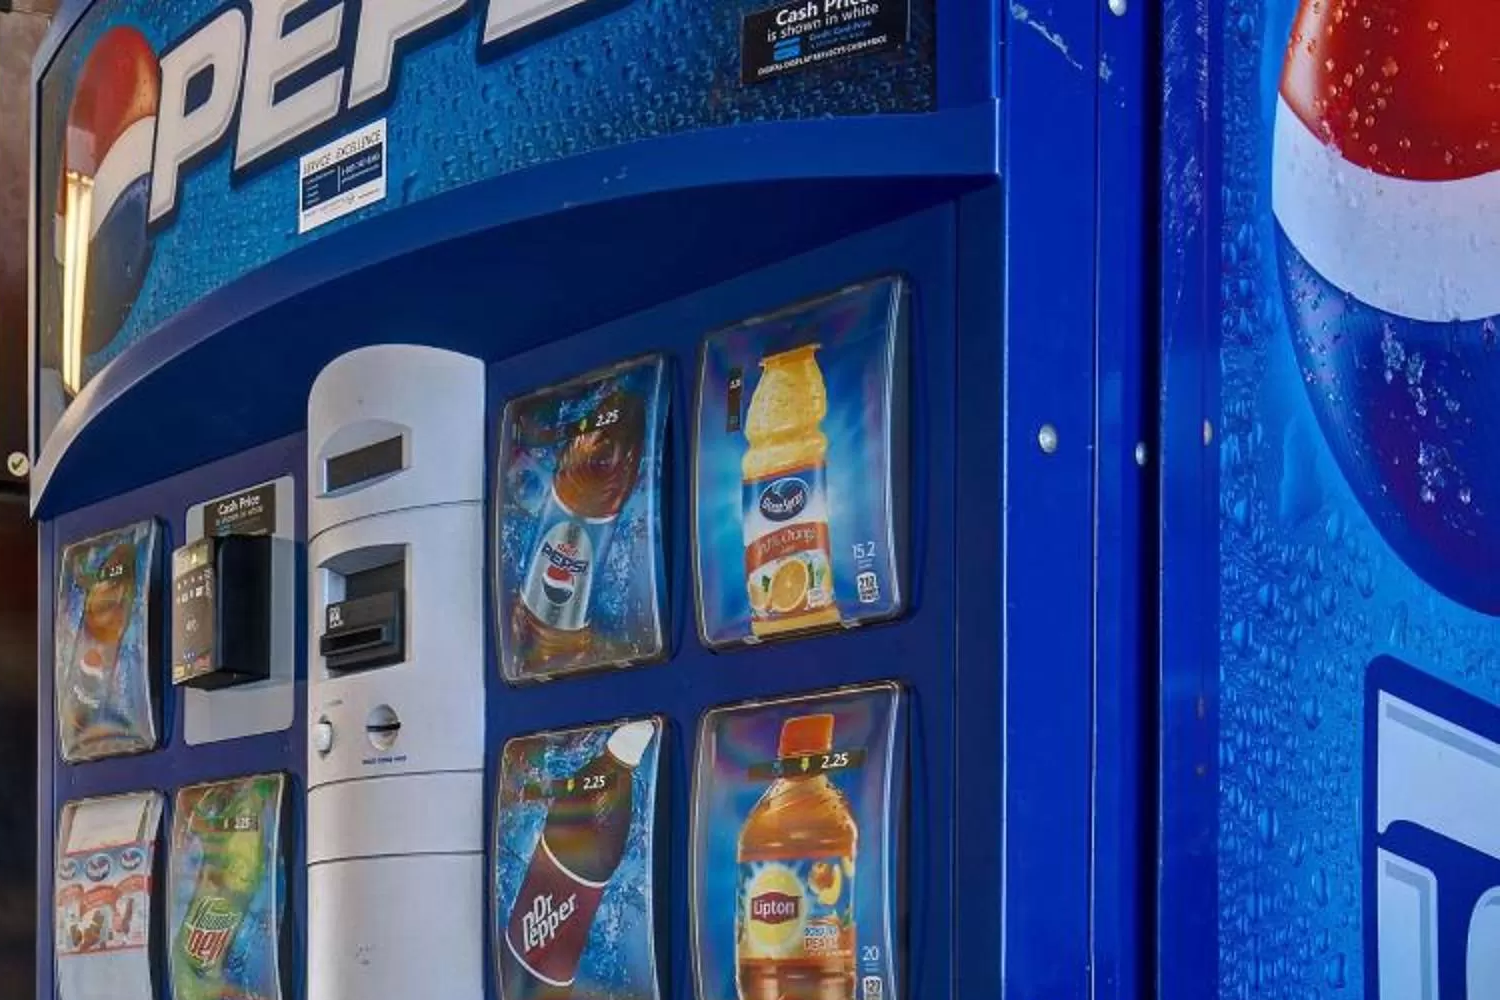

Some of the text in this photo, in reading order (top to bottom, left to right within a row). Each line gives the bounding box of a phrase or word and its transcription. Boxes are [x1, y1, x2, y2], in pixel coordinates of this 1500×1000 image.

[767, 3, 879, 42] is shown in white
[776, 0, 869, 25] Cash Pric
[596, 409, 621, 428] 2.25
[820, 751, 848, 769] 2.25
[583, 775, 605, 790] 2.25
[534, 895, 553, 920] Dr
[753, 898, 795, 918] Lipton
[522, 893, 577, 953] Pepper
